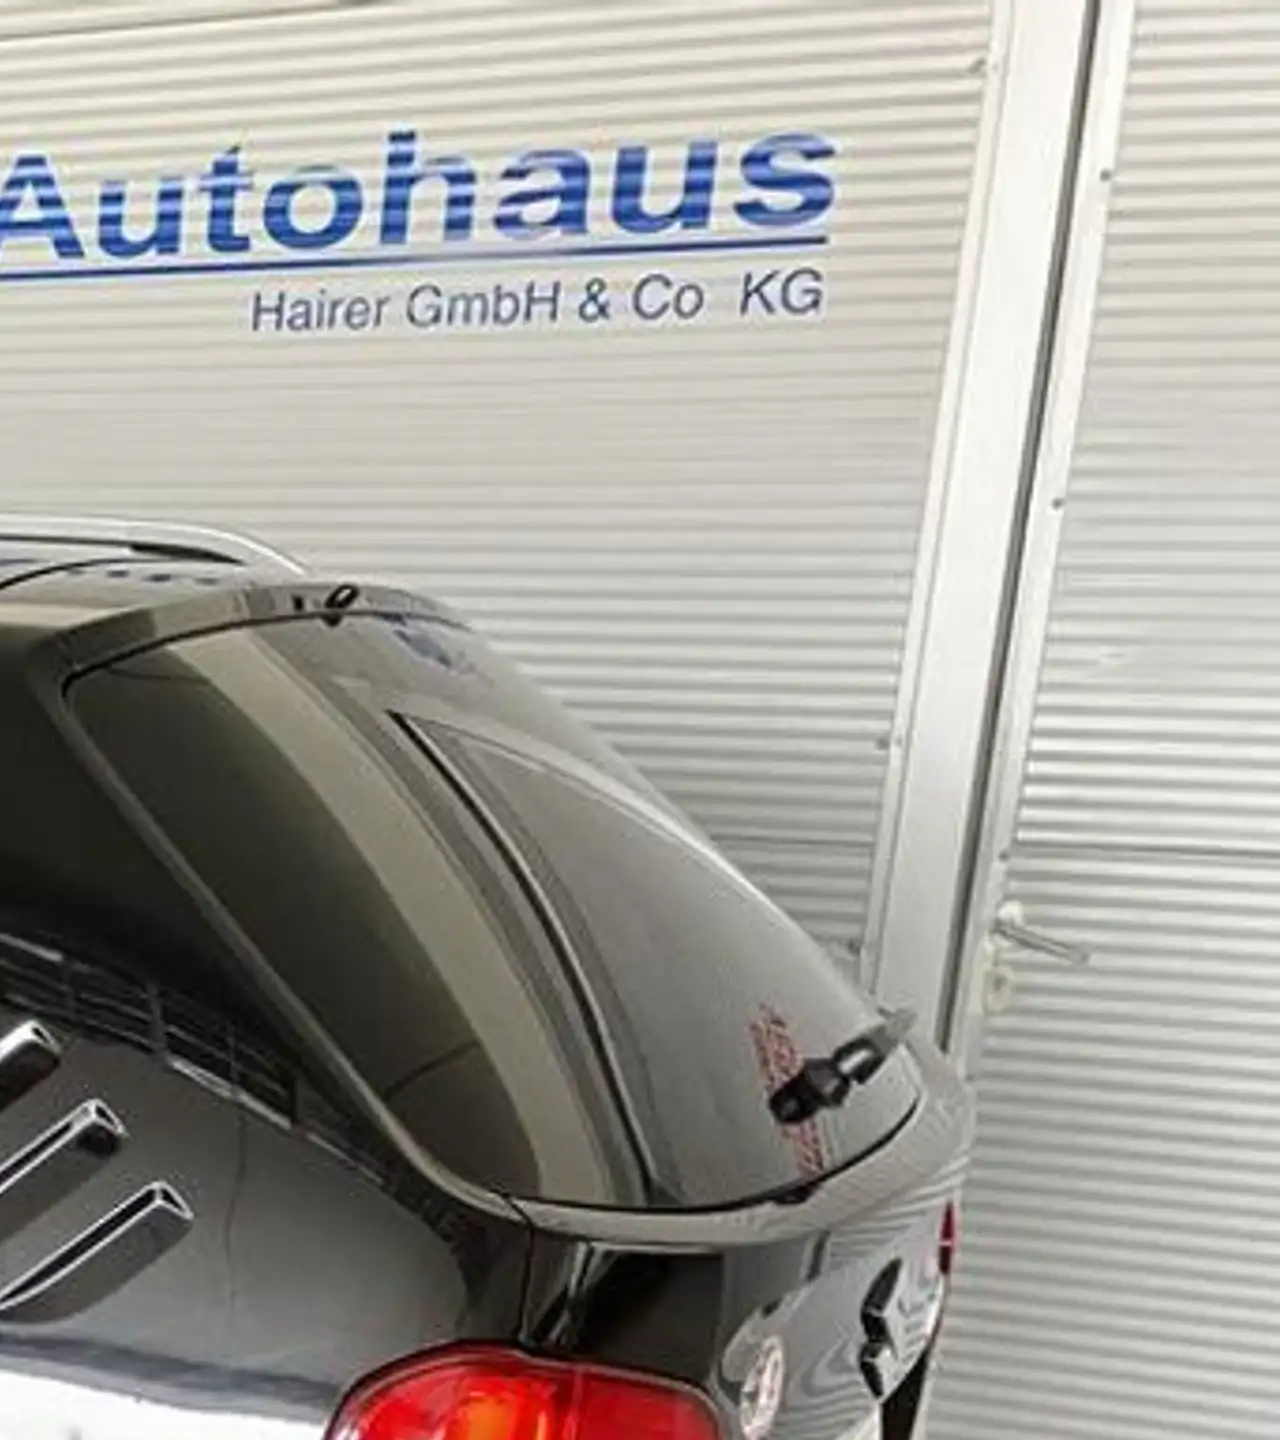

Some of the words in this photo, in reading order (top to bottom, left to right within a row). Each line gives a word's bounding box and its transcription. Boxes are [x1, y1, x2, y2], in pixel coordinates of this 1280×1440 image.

[251, 288, 392, 332] Hairer
[406, 280, 561, 328] GmbH
[577, 276, 610, 323] &
[632, 272, 705, 321] Co
[739, 267, 824, 318] KG
